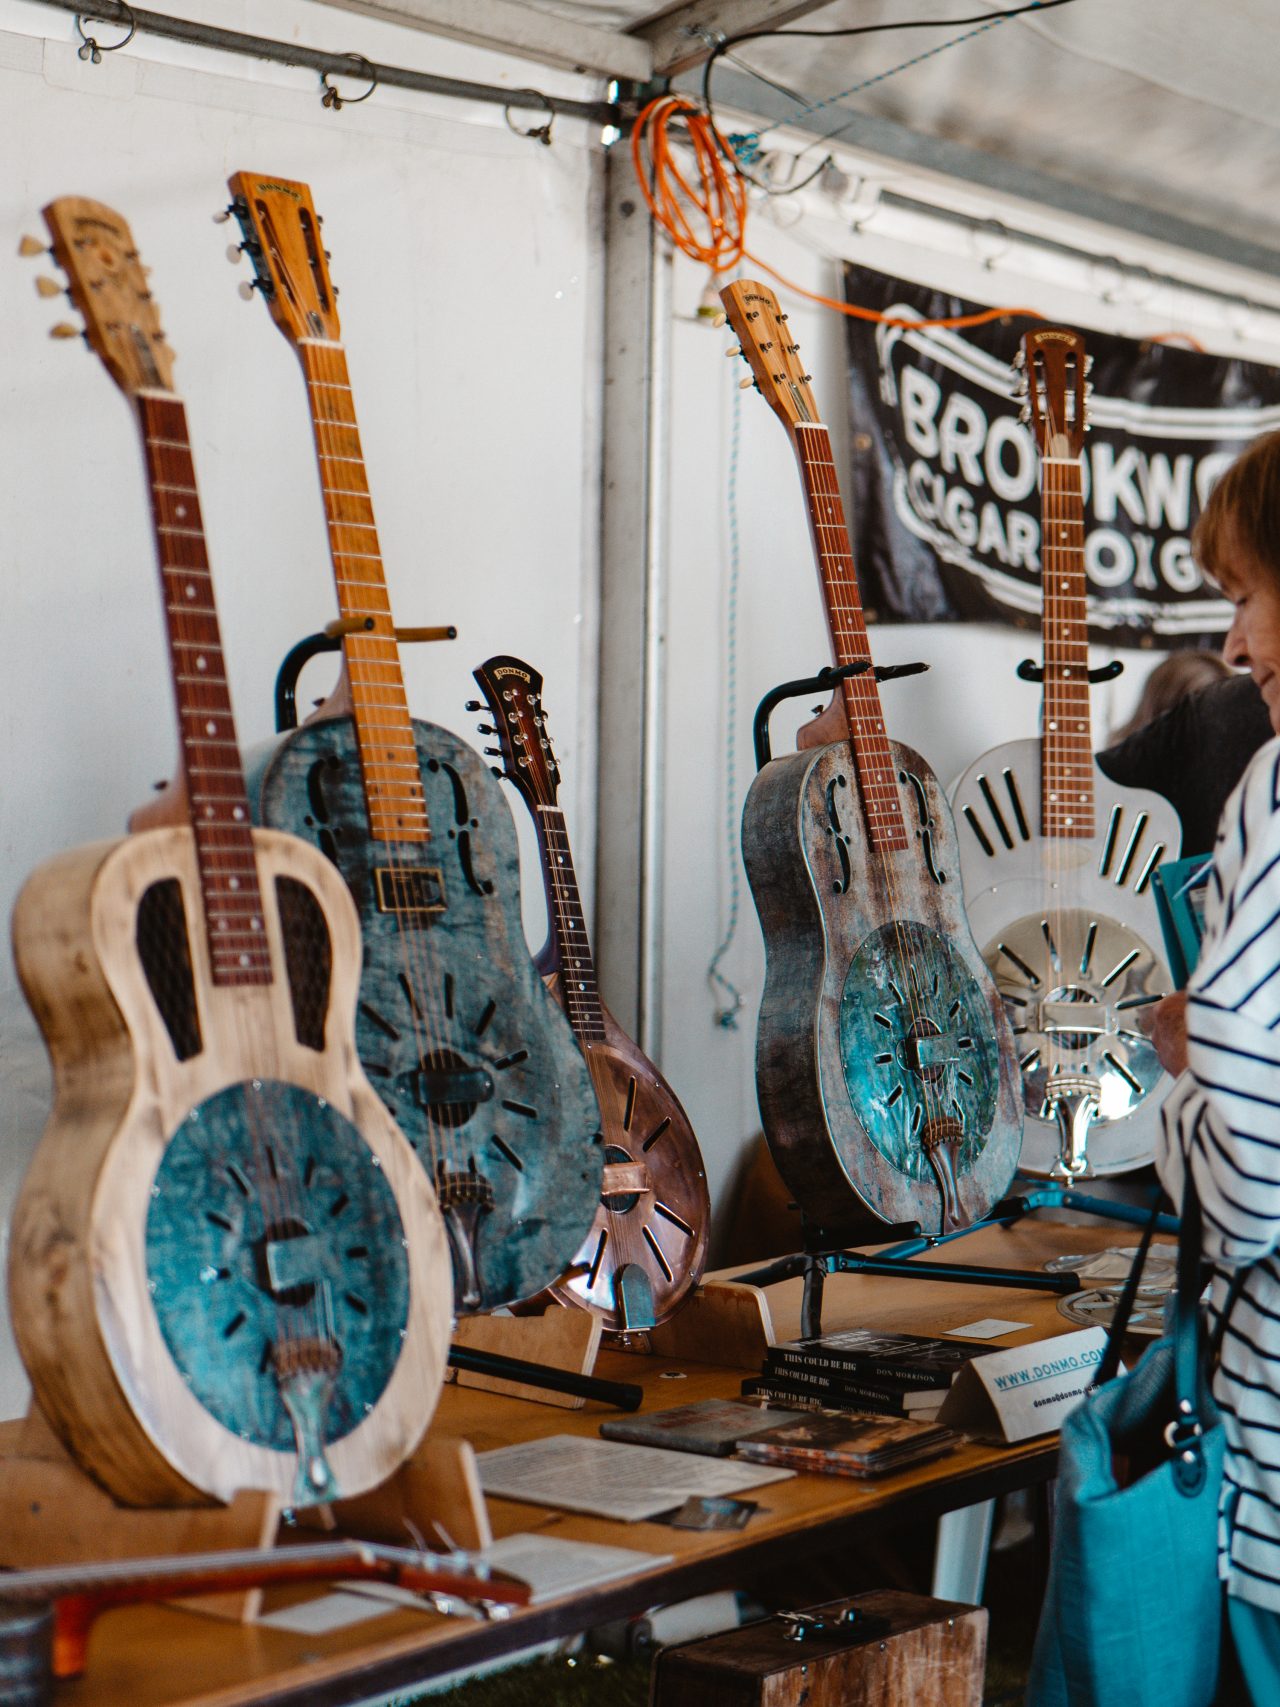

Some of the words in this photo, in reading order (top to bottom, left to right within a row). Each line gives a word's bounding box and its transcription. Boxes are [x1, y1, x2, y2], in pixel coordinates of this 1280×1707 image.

[901, 364, 1236, 531] BROKW
[909, 459, 1042, 573] CIGAR
[497, 669, 528, 678] DONMO
[783, 1353, 802, 1363] THIS
[803, 1356, 829, 1367] COULD
[830, 1359, 841, 1369] BE
[842, 1361, 857, 1371] BIG
[774, 1366, 789, 1377] THIS
[789, 1370, 809, 1382] COULD
[809, 1374, 818, 1384] BE
[818, 1377, 831, 1387] BIG
[876, 1368, 893, 1377] DON
[895, 1371, 935, 1383] MORRISON
